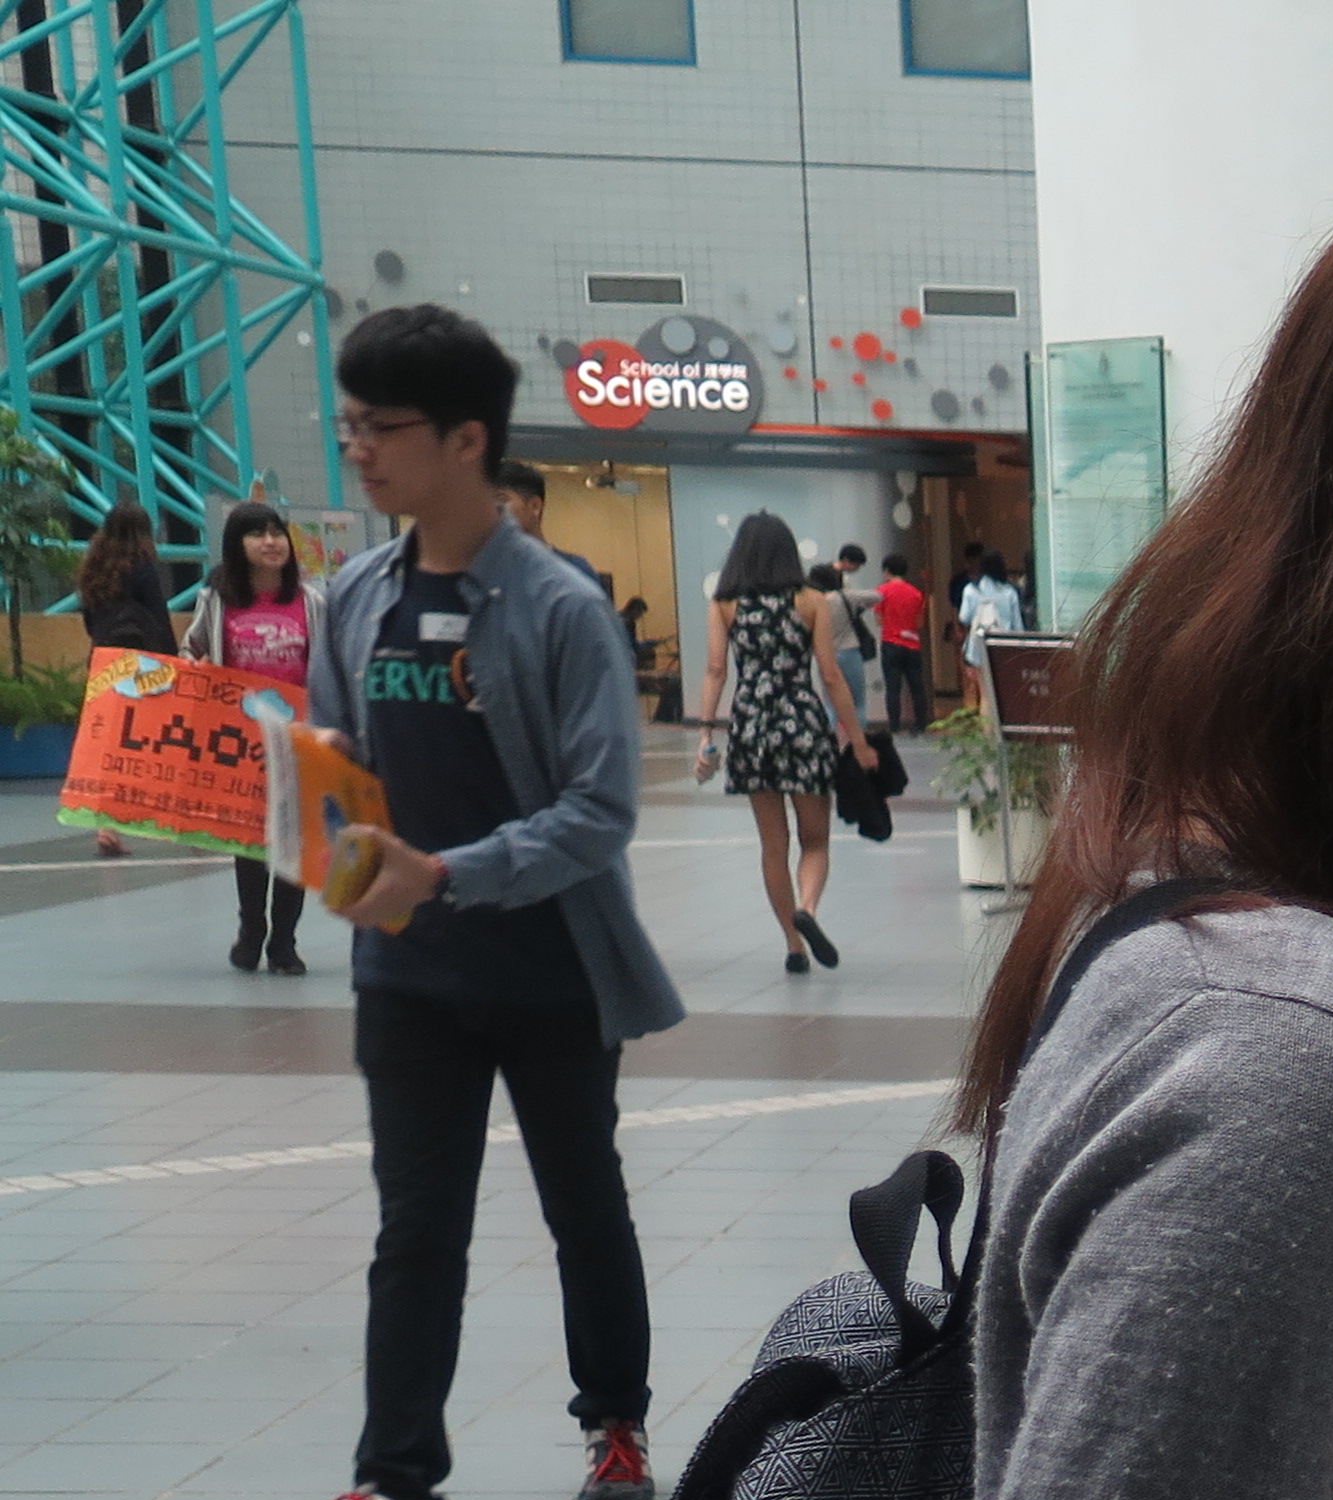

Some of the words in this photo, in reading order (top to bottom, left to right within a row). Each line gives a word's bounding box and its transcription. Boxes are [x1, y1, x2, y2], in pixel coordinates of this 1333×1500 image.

[577, 360, 750, 412] Science
[619, 359, 679, 377] School
[682, 361, 701, 378] of
